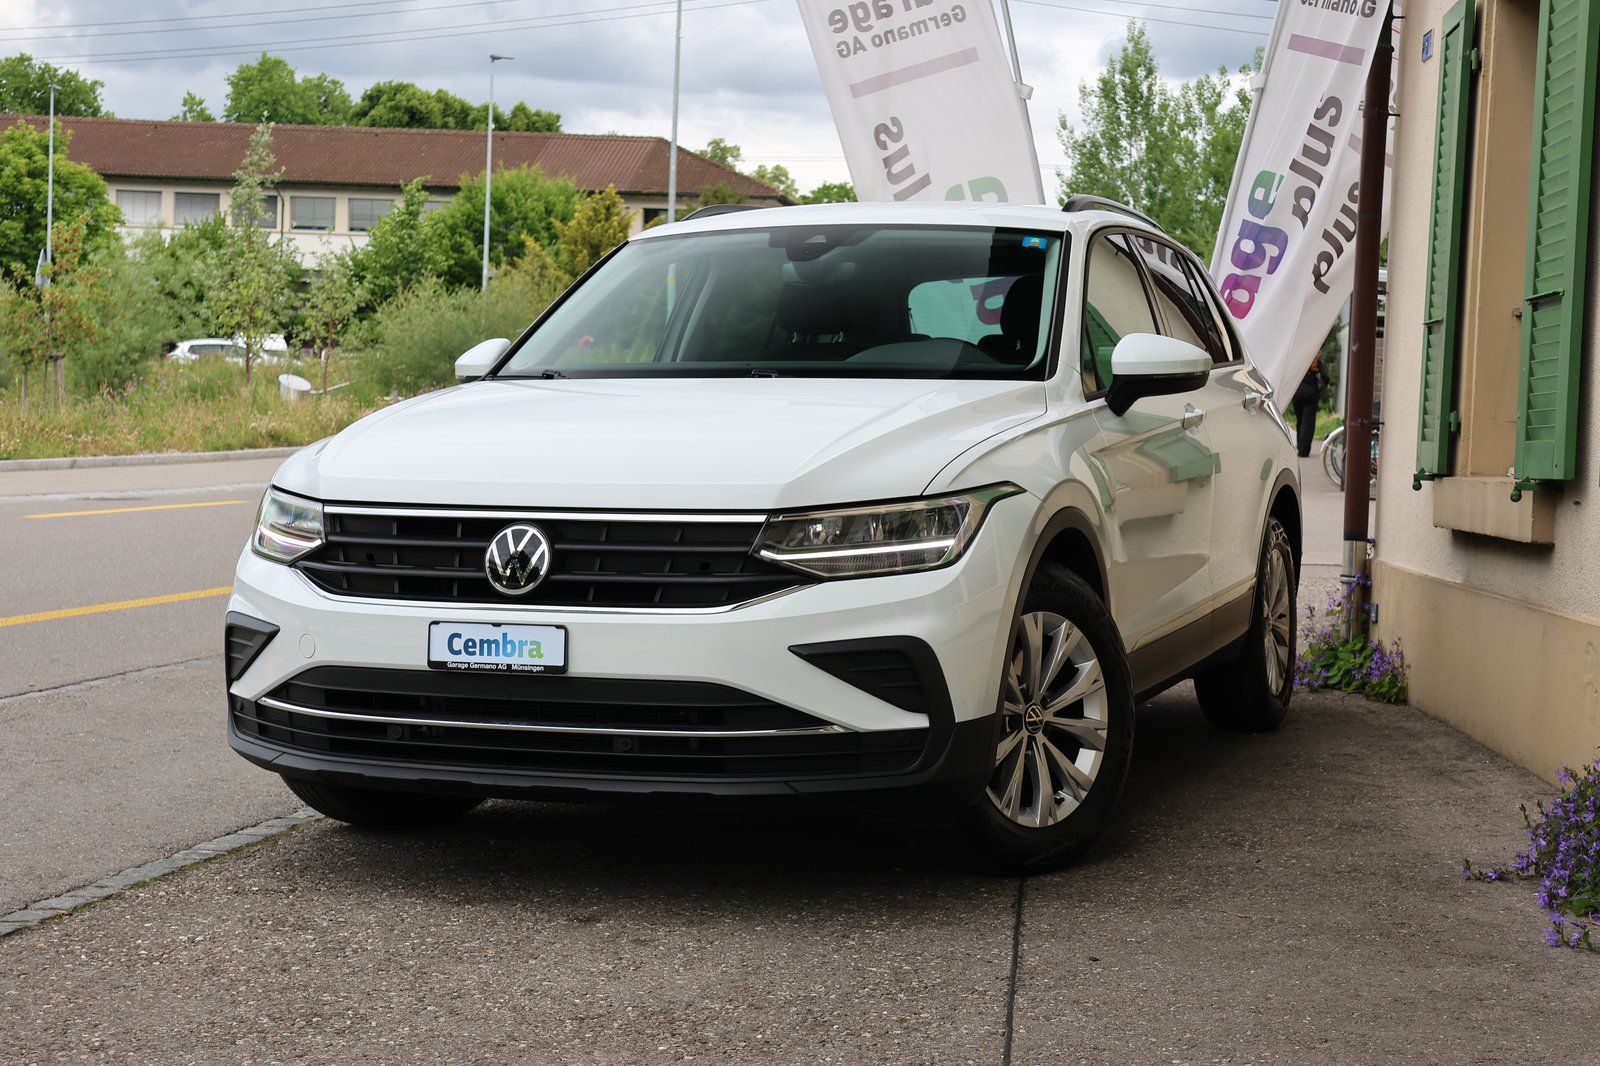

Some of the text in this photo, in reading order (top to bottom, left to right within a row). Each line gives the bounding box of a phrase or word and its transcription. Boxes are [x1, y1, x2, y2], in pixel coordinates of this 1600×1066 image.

[447, 632, 543, 659] Cembra
[447, 661, 468, 670] Garage
[469, 662, 497, 670] Germano
[511, 664, 544, 672] Münsingen
